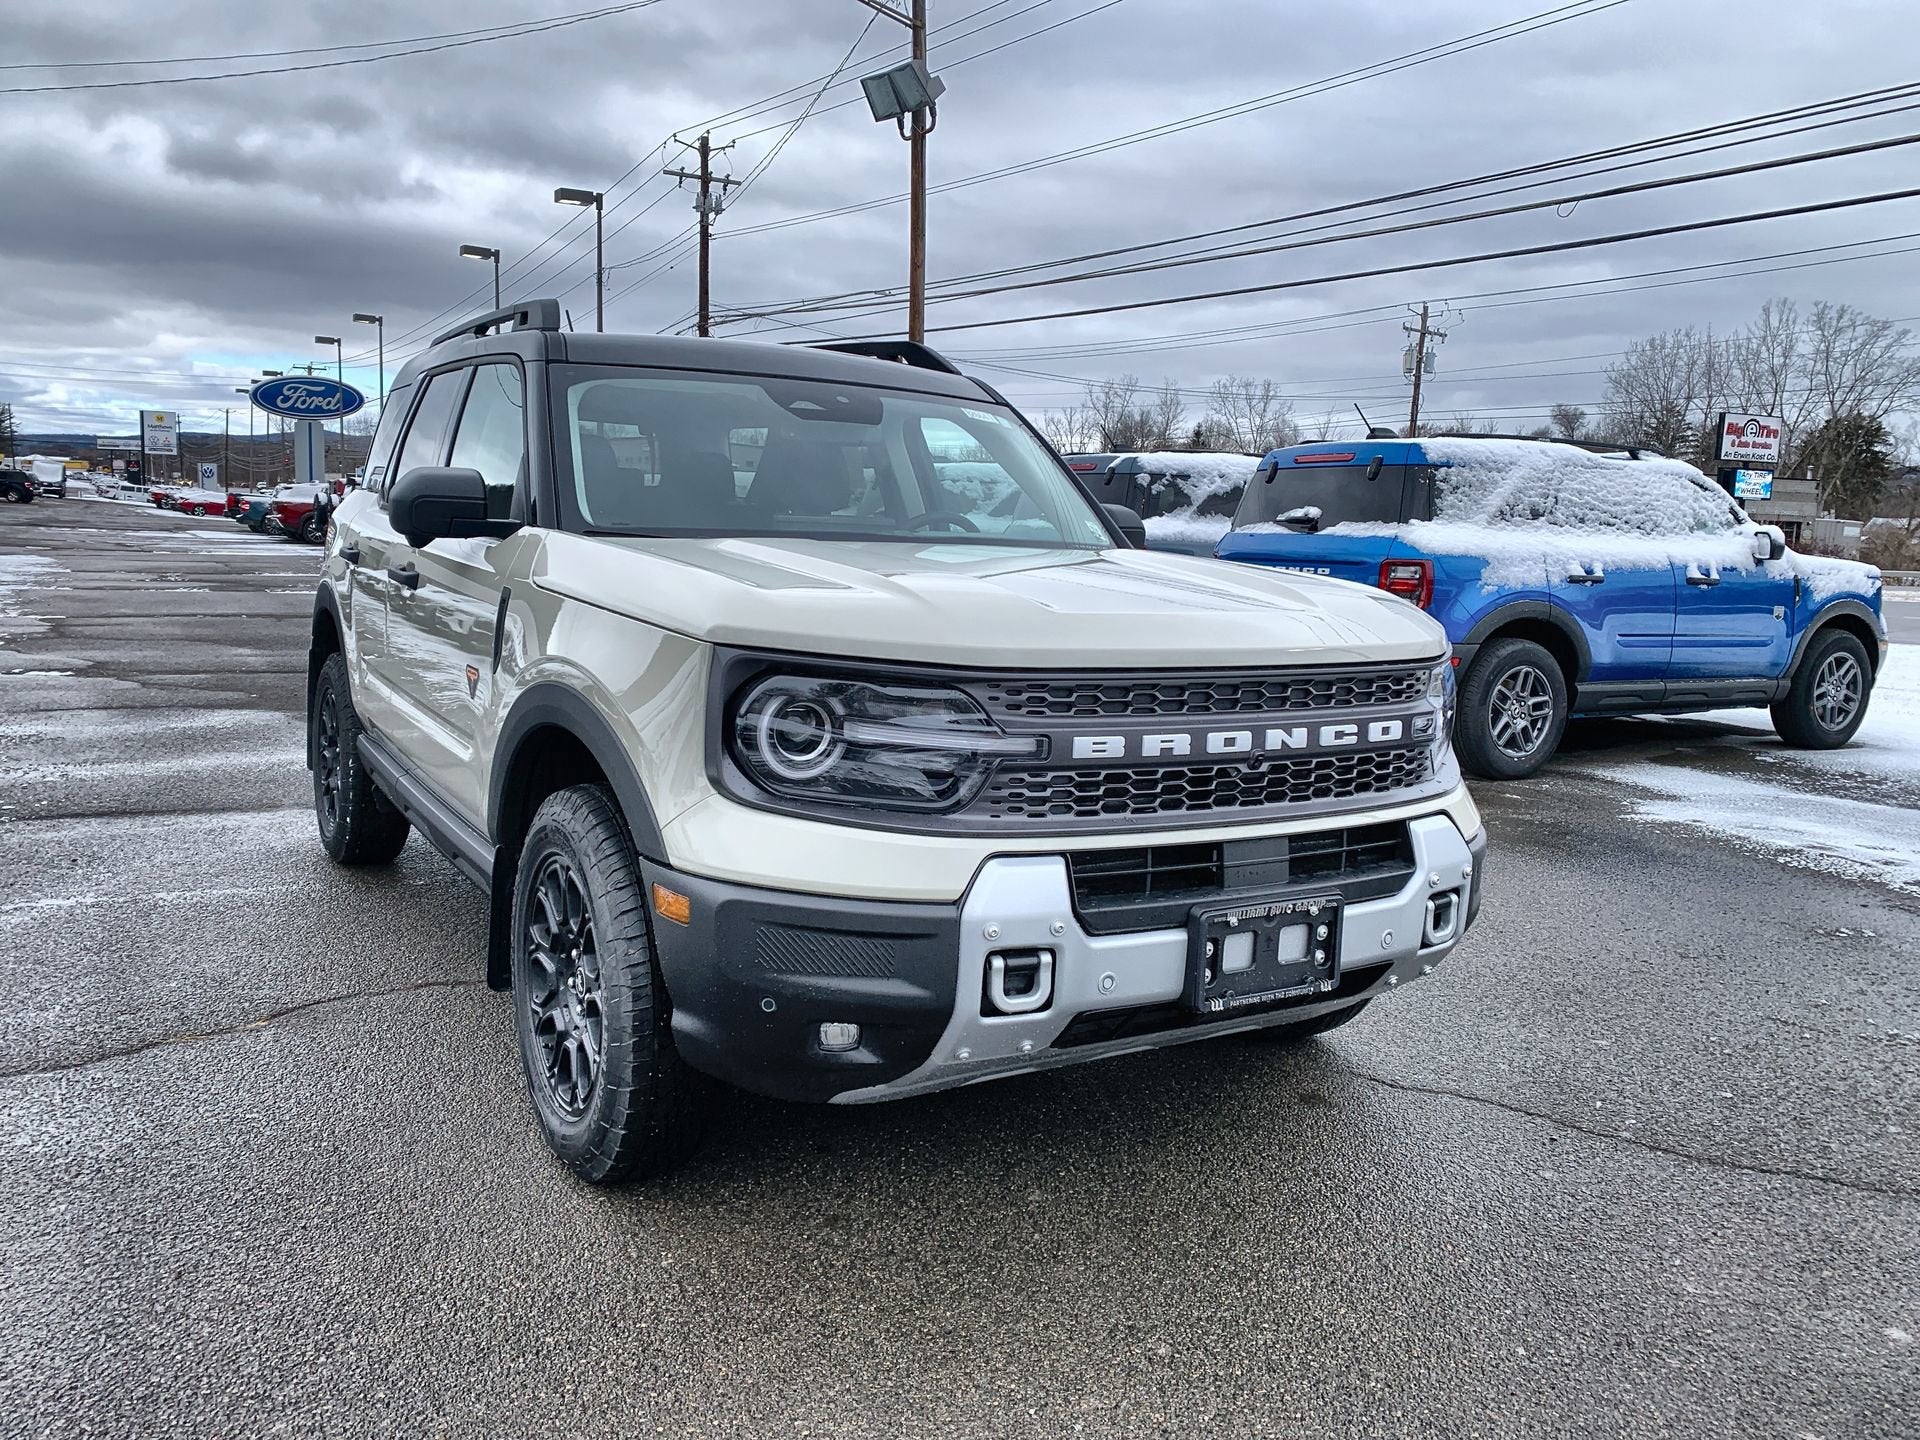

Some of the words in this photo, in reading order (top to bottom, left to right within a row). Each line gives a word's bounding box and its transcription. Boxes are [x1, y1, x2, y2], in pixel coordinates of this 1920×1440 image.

[276, 384, 341, 410] Ford
[1726, 422, 1744, 439] Big
[1760, 425, 1779, 439] Tire
[1733, 451, 1750, 459] Erwin
[1766, 453, 1777, 461] Co.
[1072, 719, 1403, 760] BRONCO
